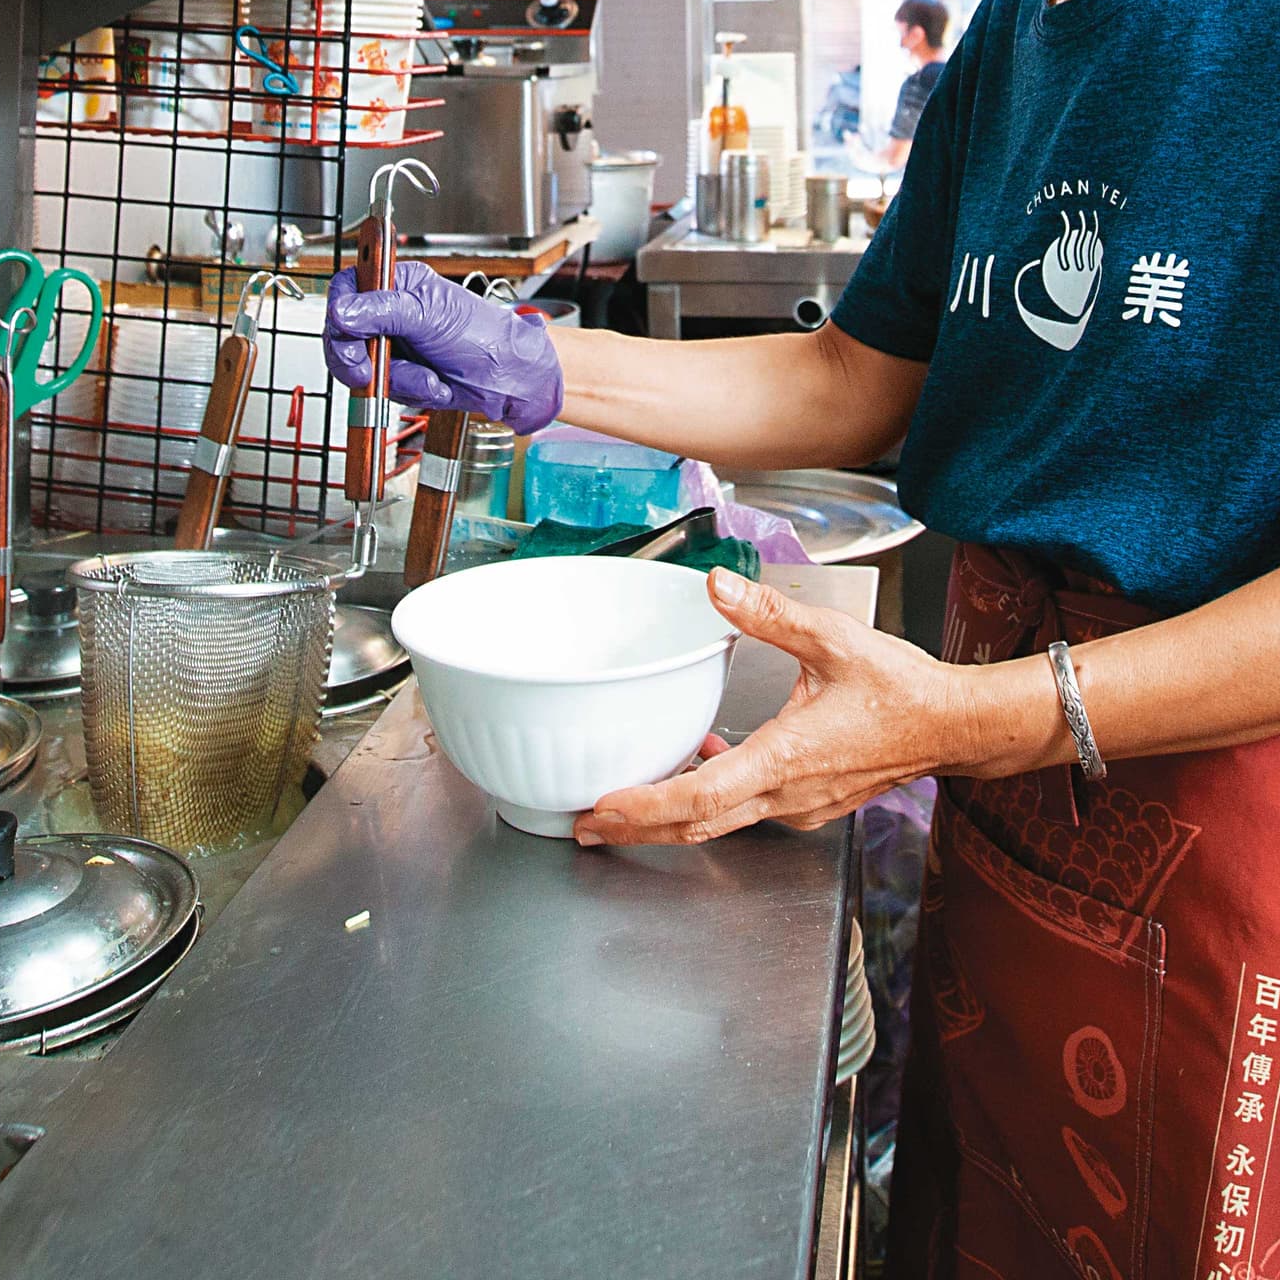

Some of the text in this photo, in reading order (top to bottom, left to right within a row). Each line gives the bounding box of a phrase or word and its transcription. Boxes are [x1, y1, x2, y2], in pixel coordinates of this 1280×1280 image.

[1025, 179, 1128, 215] CHUAN YEI
[949, 251, 1190, 328] 川 業
